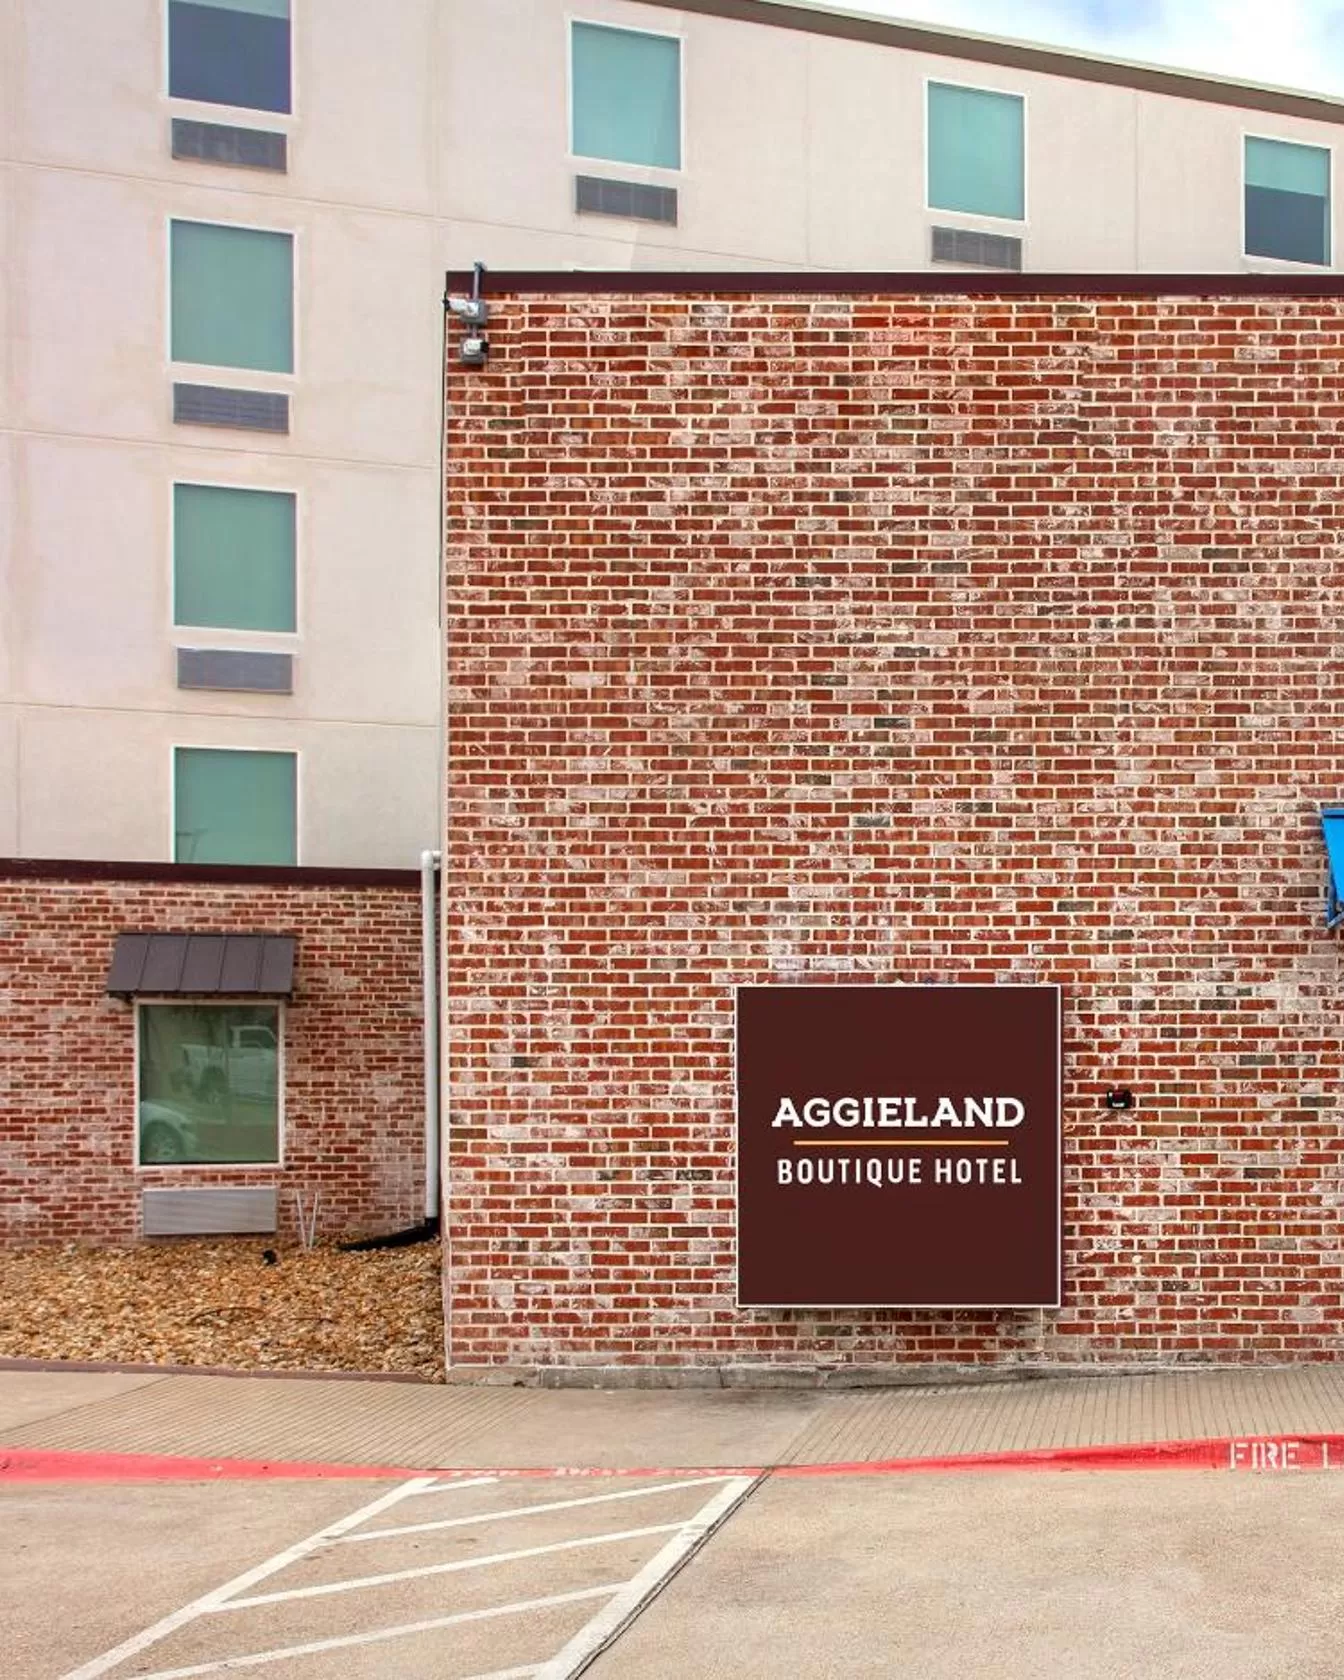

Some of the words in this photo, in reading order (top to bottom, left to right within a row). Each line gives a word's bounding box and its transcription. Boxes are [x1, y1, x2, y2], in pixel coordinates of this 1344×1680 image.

[771, 1097, 1026, 1128] AGGIELAND
[776, 1157, 922, 1188] BOUTIQUE
[934, 1157, 1022, 1184] HOTEL
[1228, 1441, 1299, 1471] FIRE
